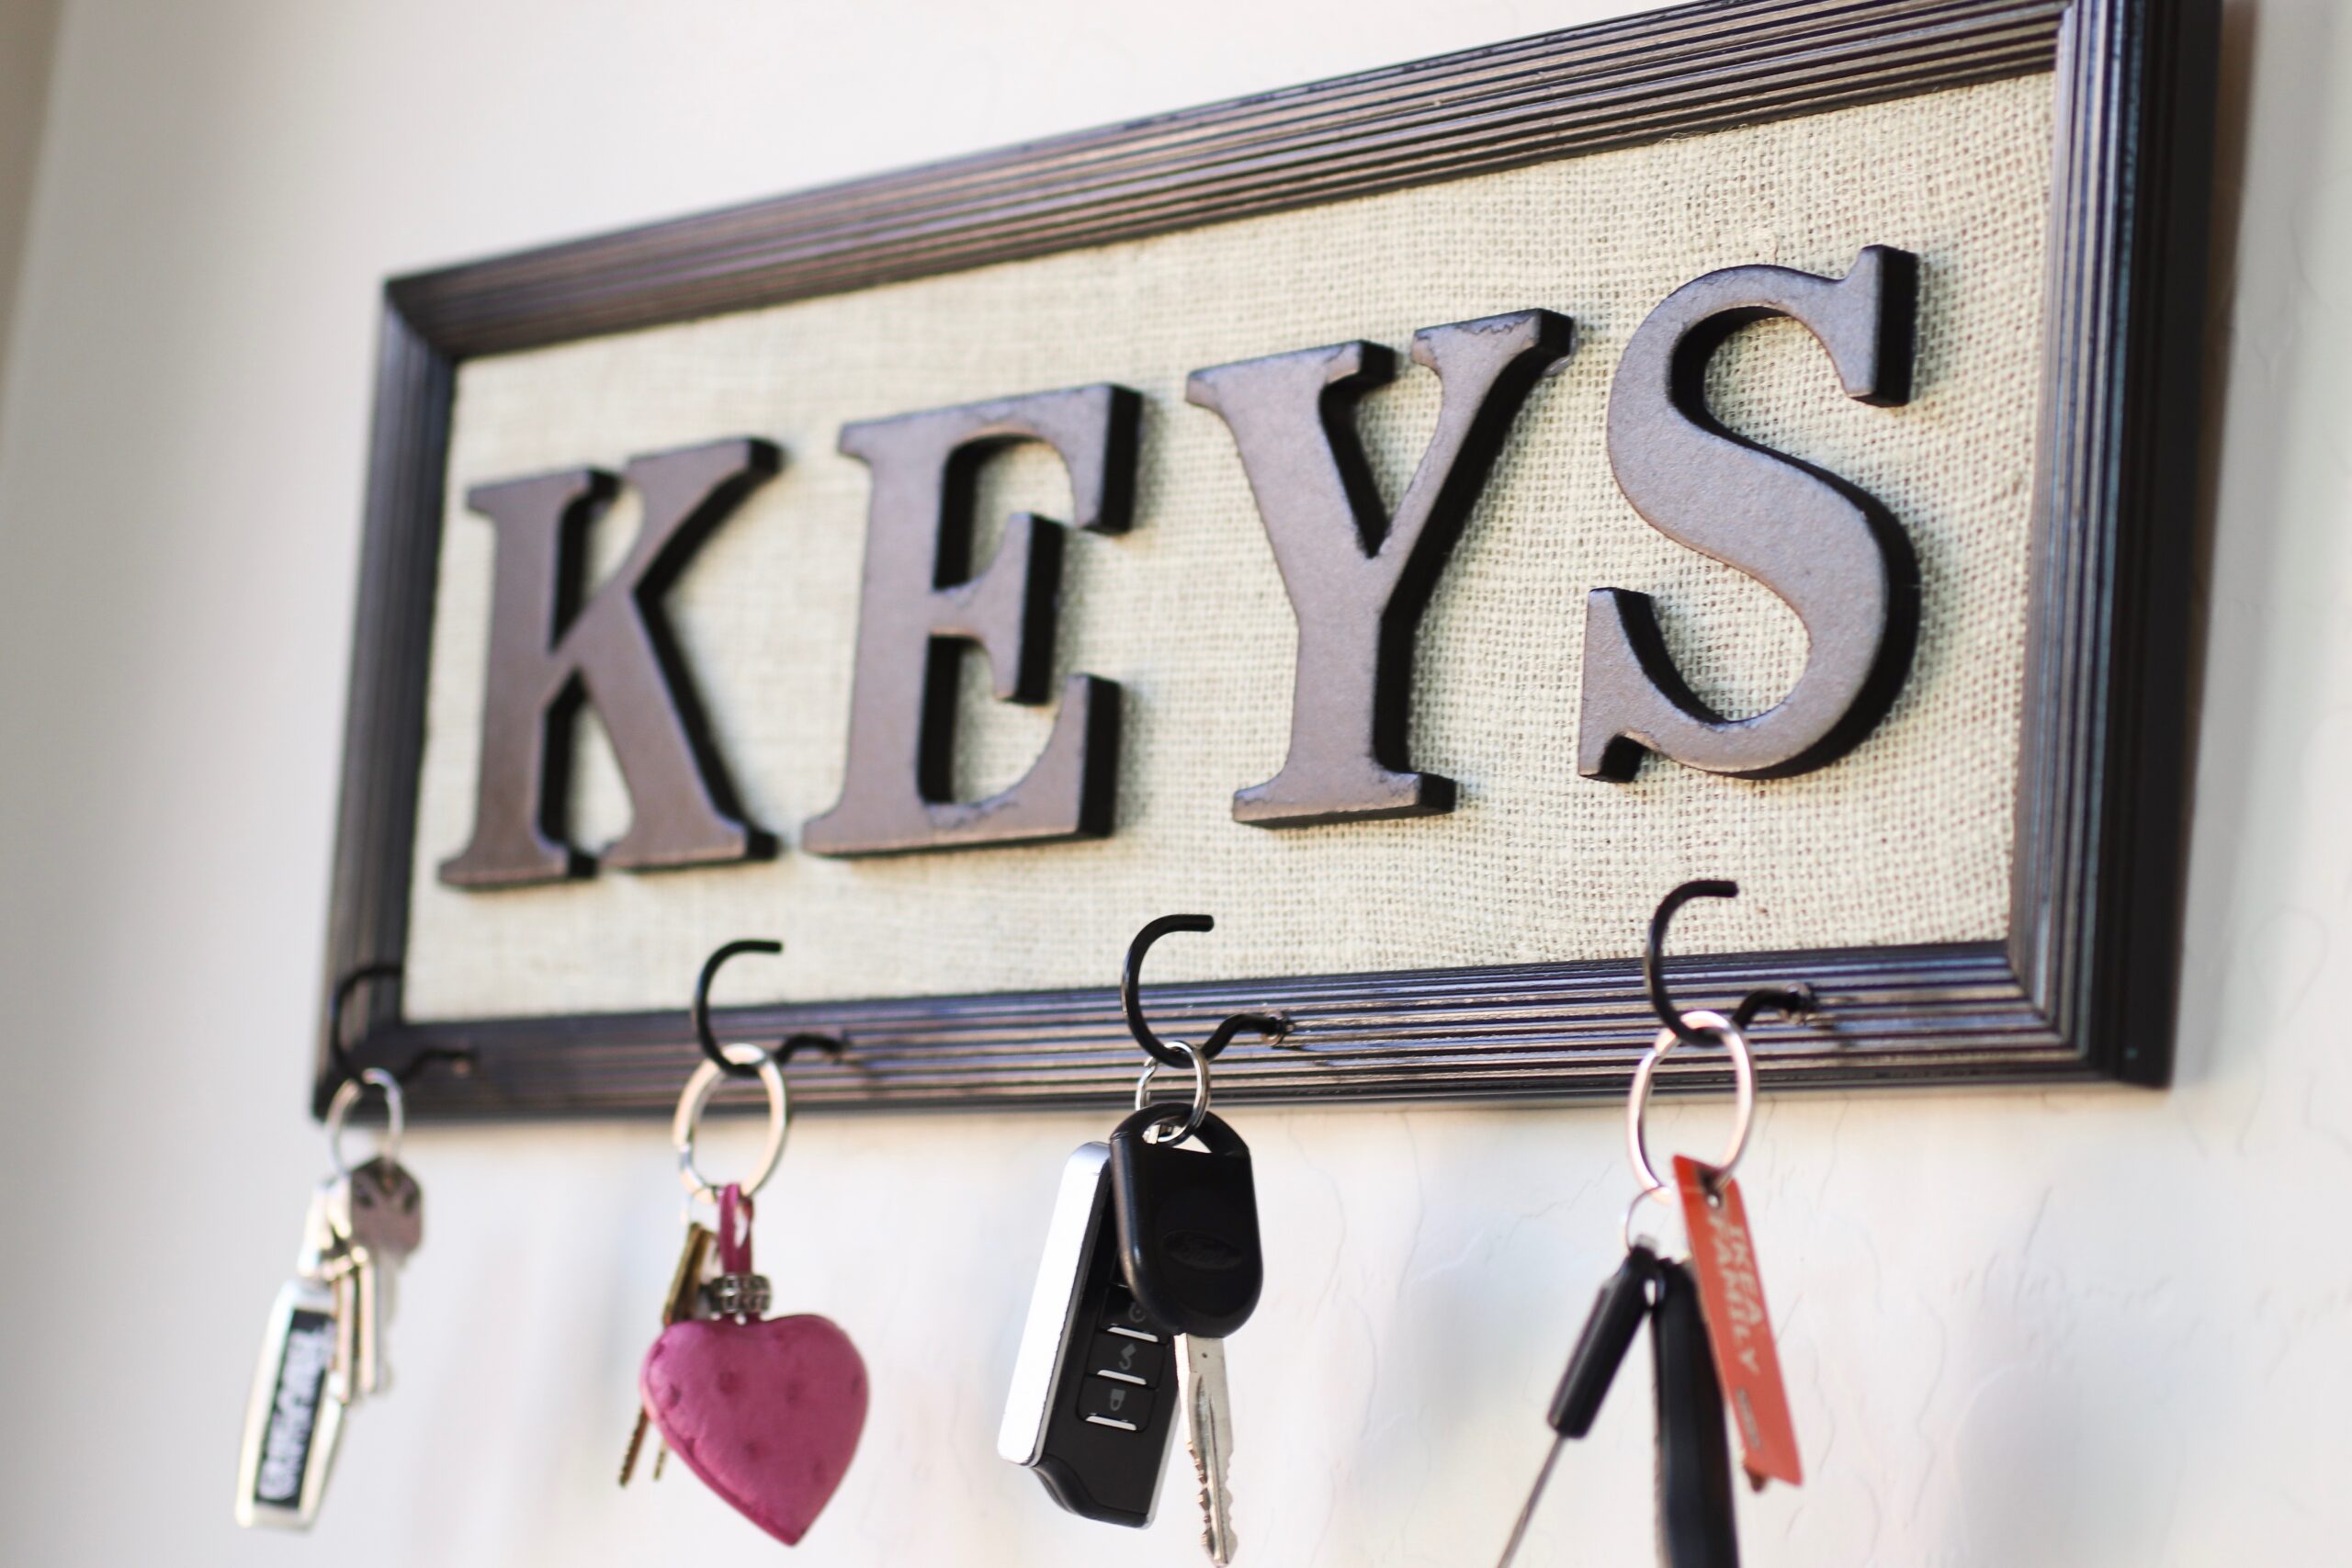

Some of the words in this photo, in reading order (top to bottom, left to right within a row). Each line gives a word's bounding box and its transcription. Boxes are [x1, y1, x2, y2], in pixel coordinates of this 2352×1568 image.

[435, 244, 1920, 891] KEYS
[1708, 1213, 1761, 1375] FAMILY
[1725, 1224, 1763, 1325] IKEA
